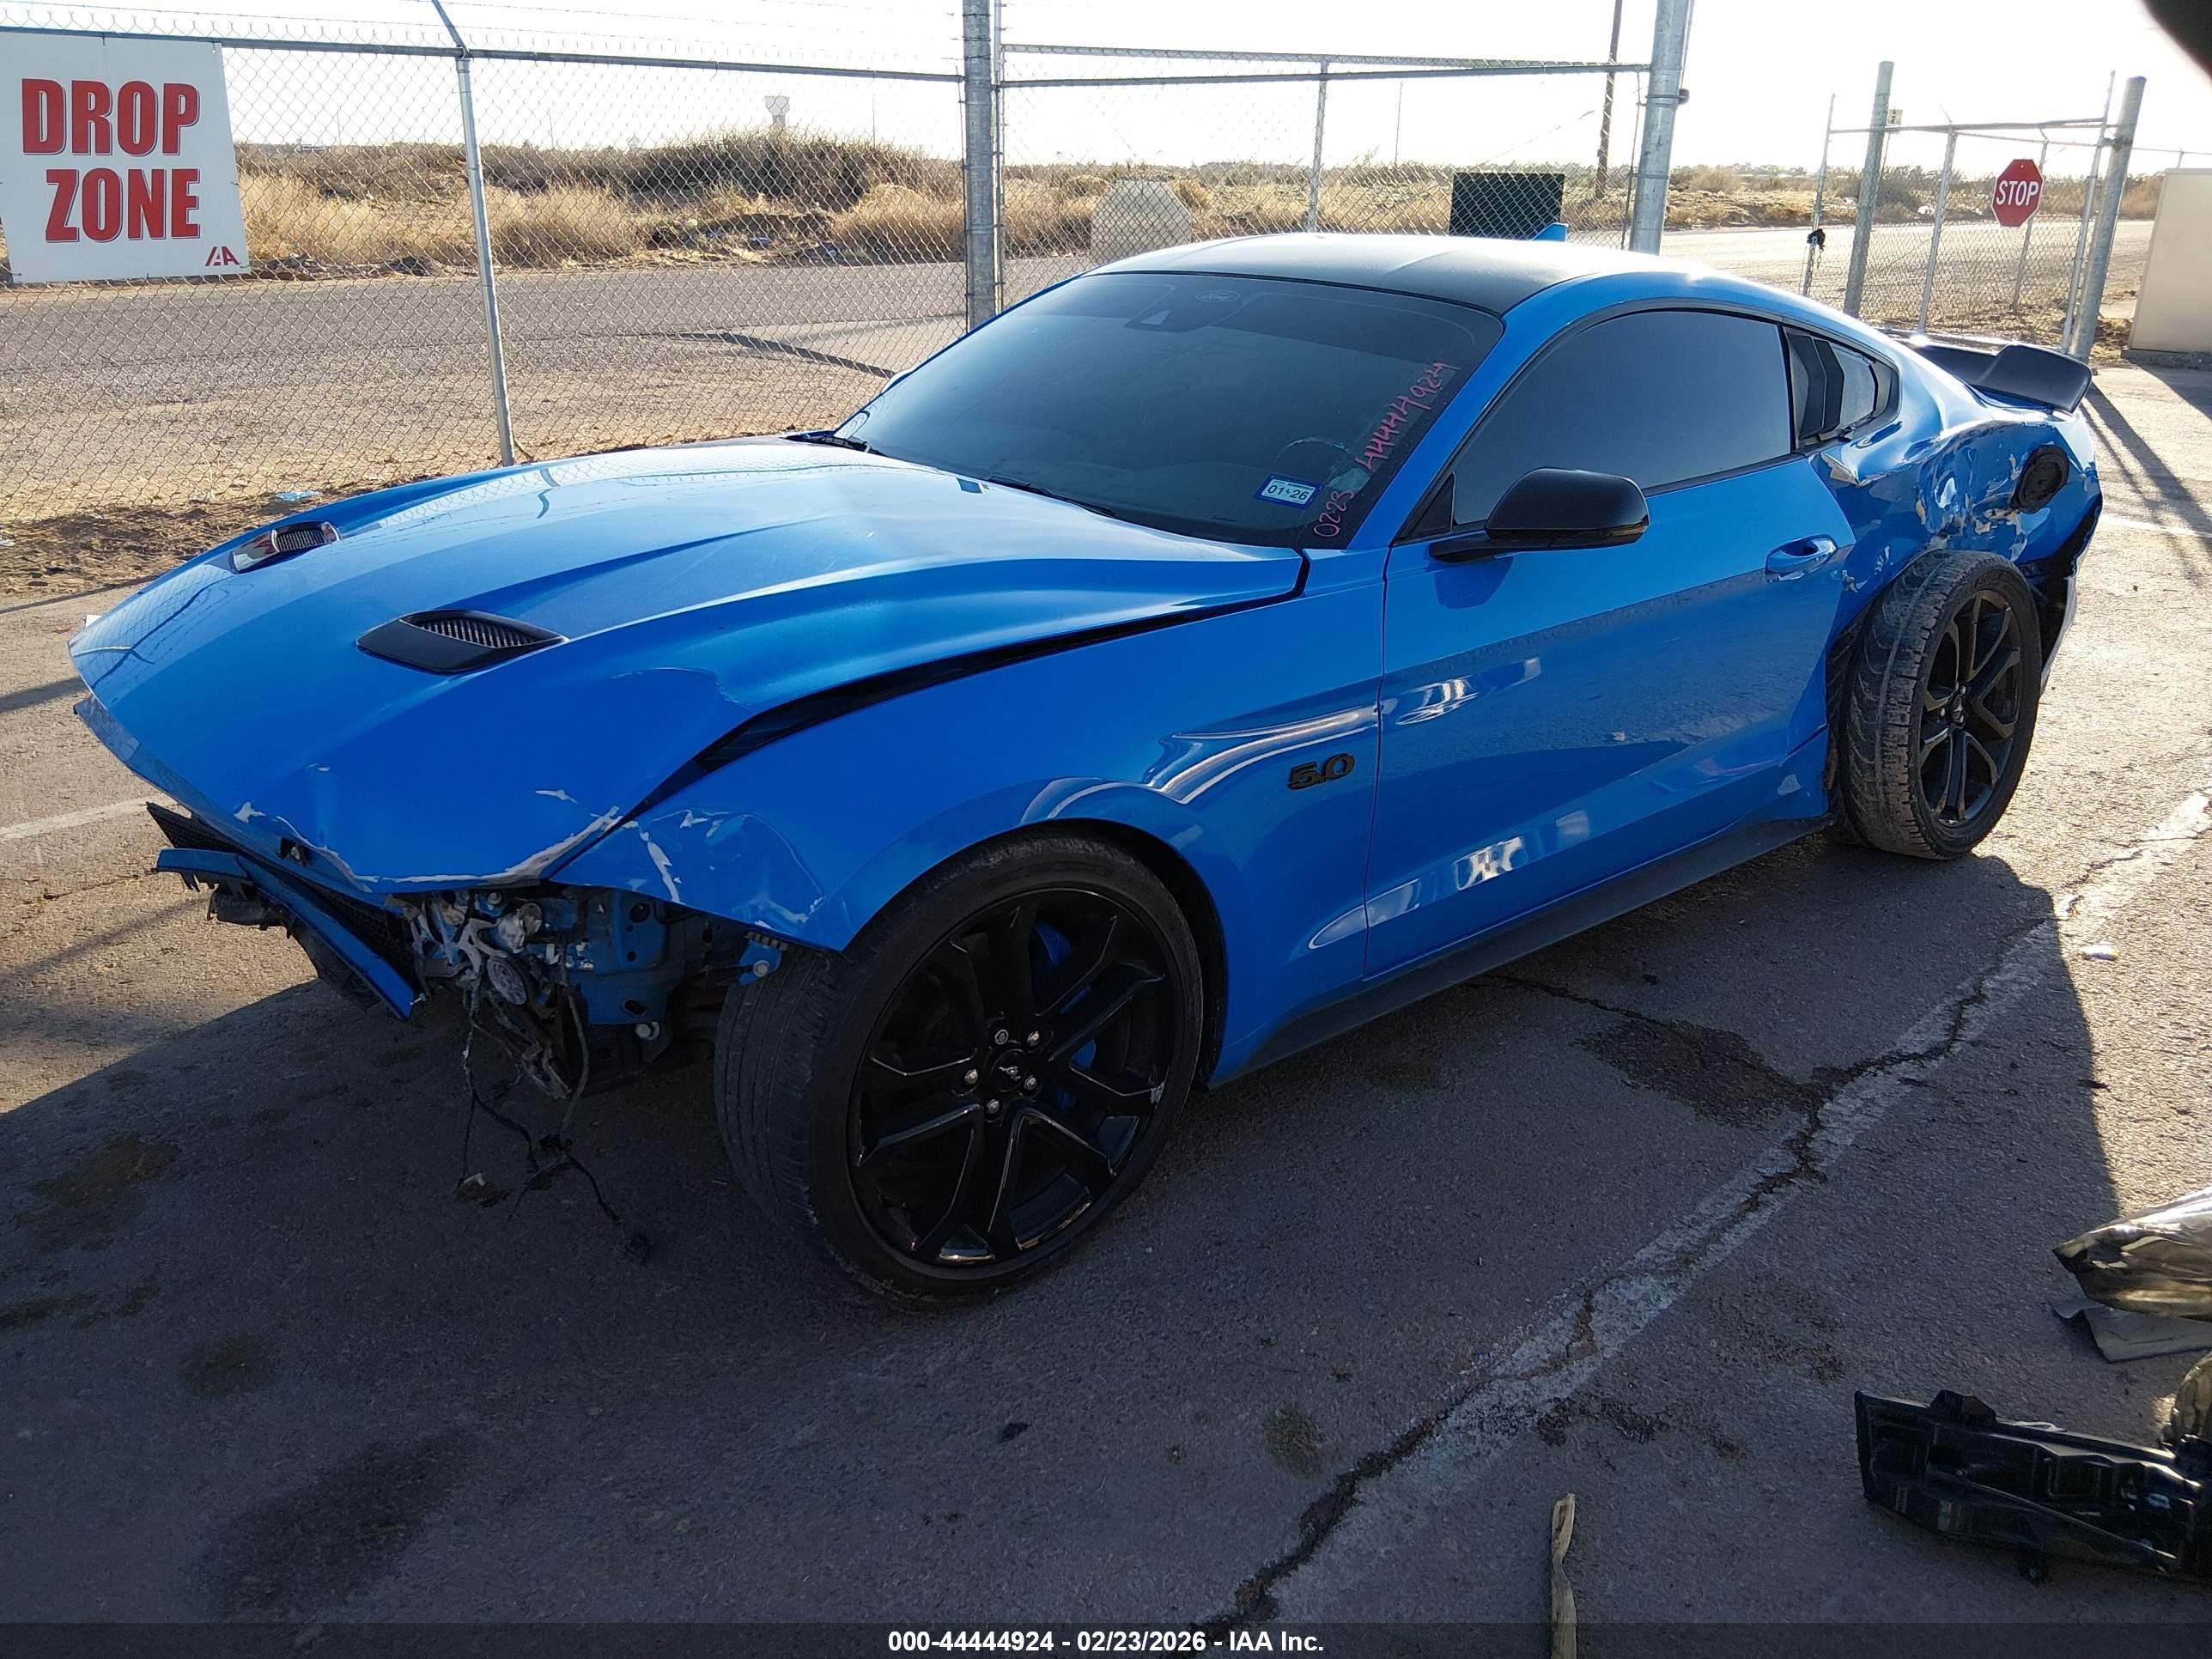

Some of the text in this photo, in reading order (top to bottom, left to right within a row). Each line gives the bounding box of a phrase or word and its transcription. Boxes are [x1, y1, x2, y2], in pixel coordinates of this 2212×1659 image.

[21, 78, 200, 156] DROP
[45, 167, 201, 243] ZONE
[1996, 179, 2039, 207] STOP
[1289, 489, 1310, 501] 26
[1287, 752, 1355, 790] 5.0
